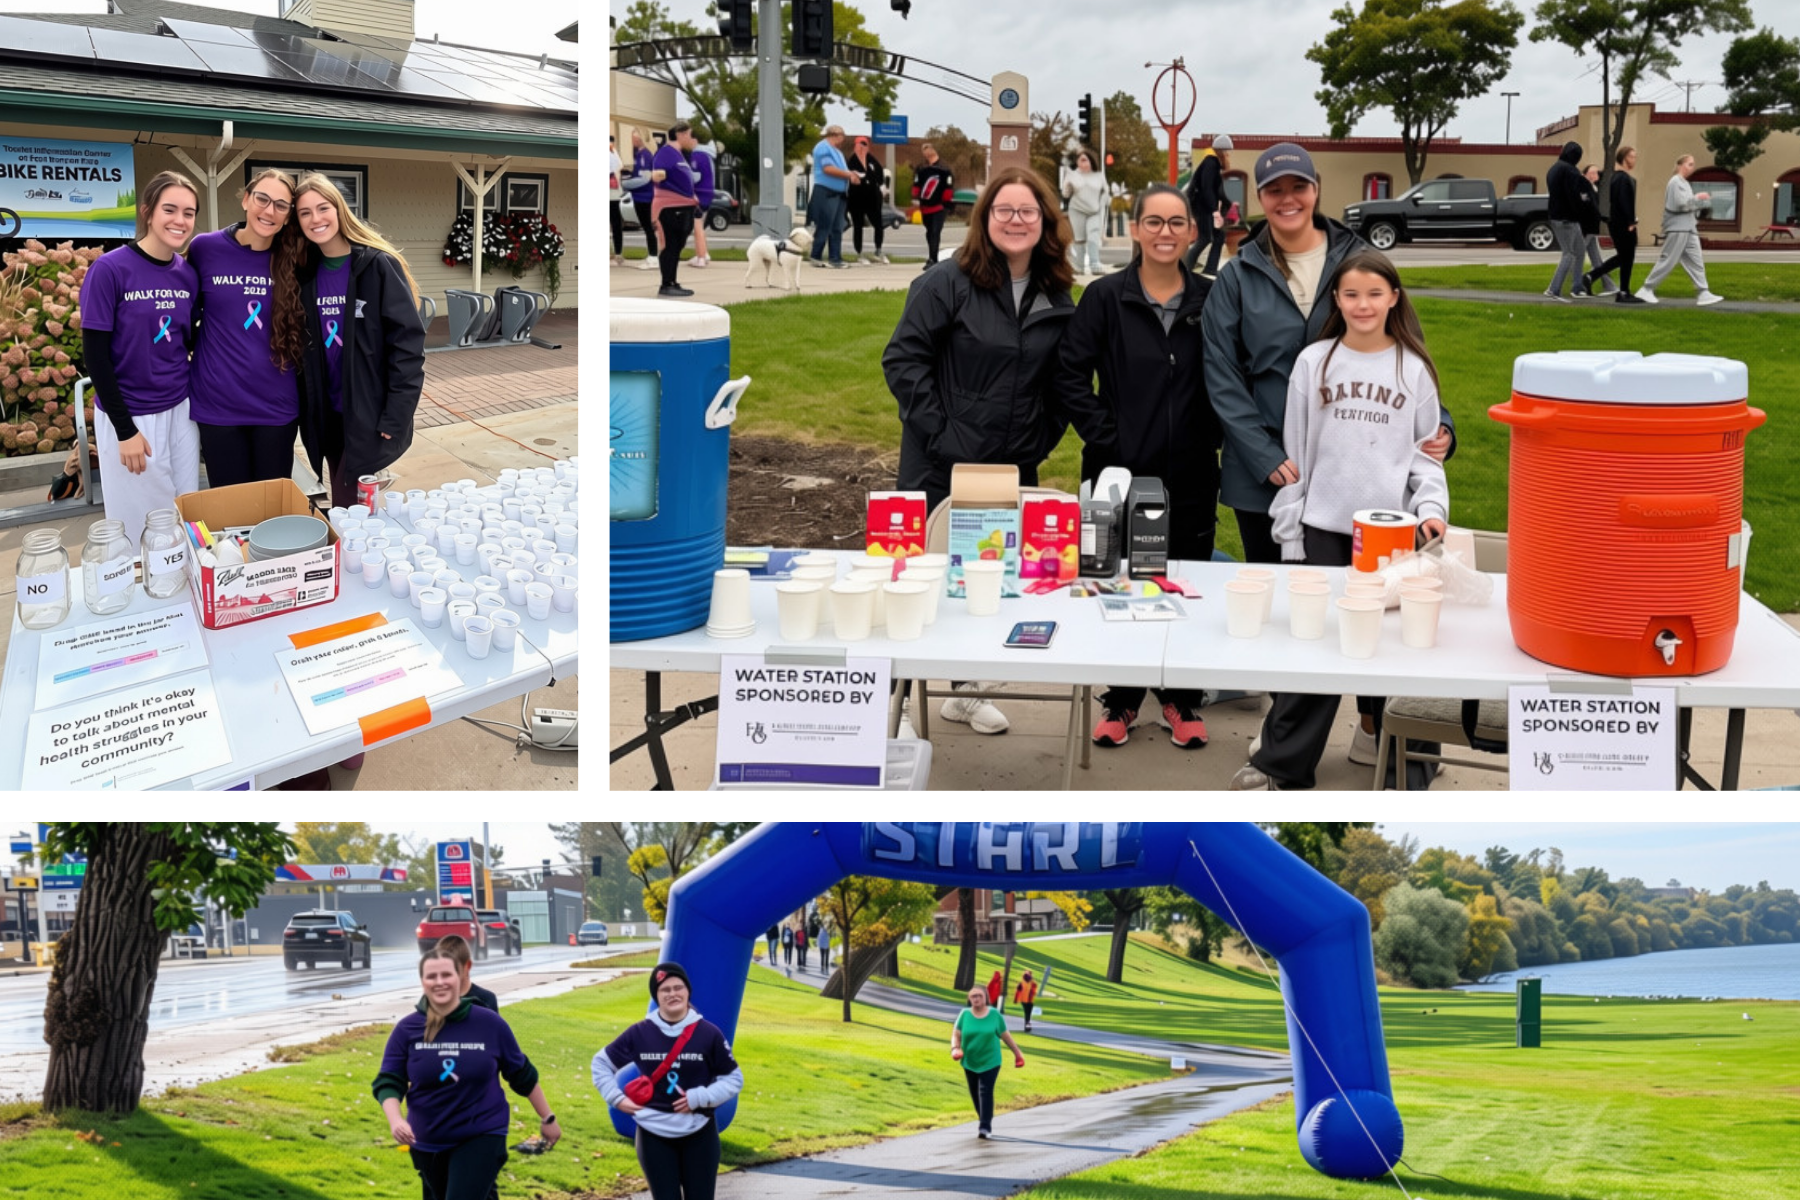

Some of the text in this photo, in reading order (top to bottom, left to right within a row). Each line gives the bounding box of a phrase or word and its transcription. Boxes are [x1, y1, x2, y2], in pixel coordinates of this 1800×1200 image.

[0, 163, 122, 182] BIKE RENTALS
[212, 275, 244, 286] WALK
[245, 276, 267, 286] FOR
[124, 289, 154, 302] WALK
[163, 551, 184, 565] YES
[27, 584, 48, 596] NO
[735, 669, 876, 685] WATER STATION
[735, 688, 874, 705] SPONSORED BY
[50, 721, 72, 734] Do
[74, 713, 101, 729] you
[165, 687, 196, 701] okay
[1521, 699, 1661, 715] WATER STATION
[53, 698, 196, 747] to talk about mental
[1522, 719, 1659, 734] SPONSORED BY
[39, 744, 89, 766] health
[92, 723, 160, 751] struggles
[178, 709, 208, 727] your
[81, 731, 175, 769] community?
[875, 822, 1118, 871] START
